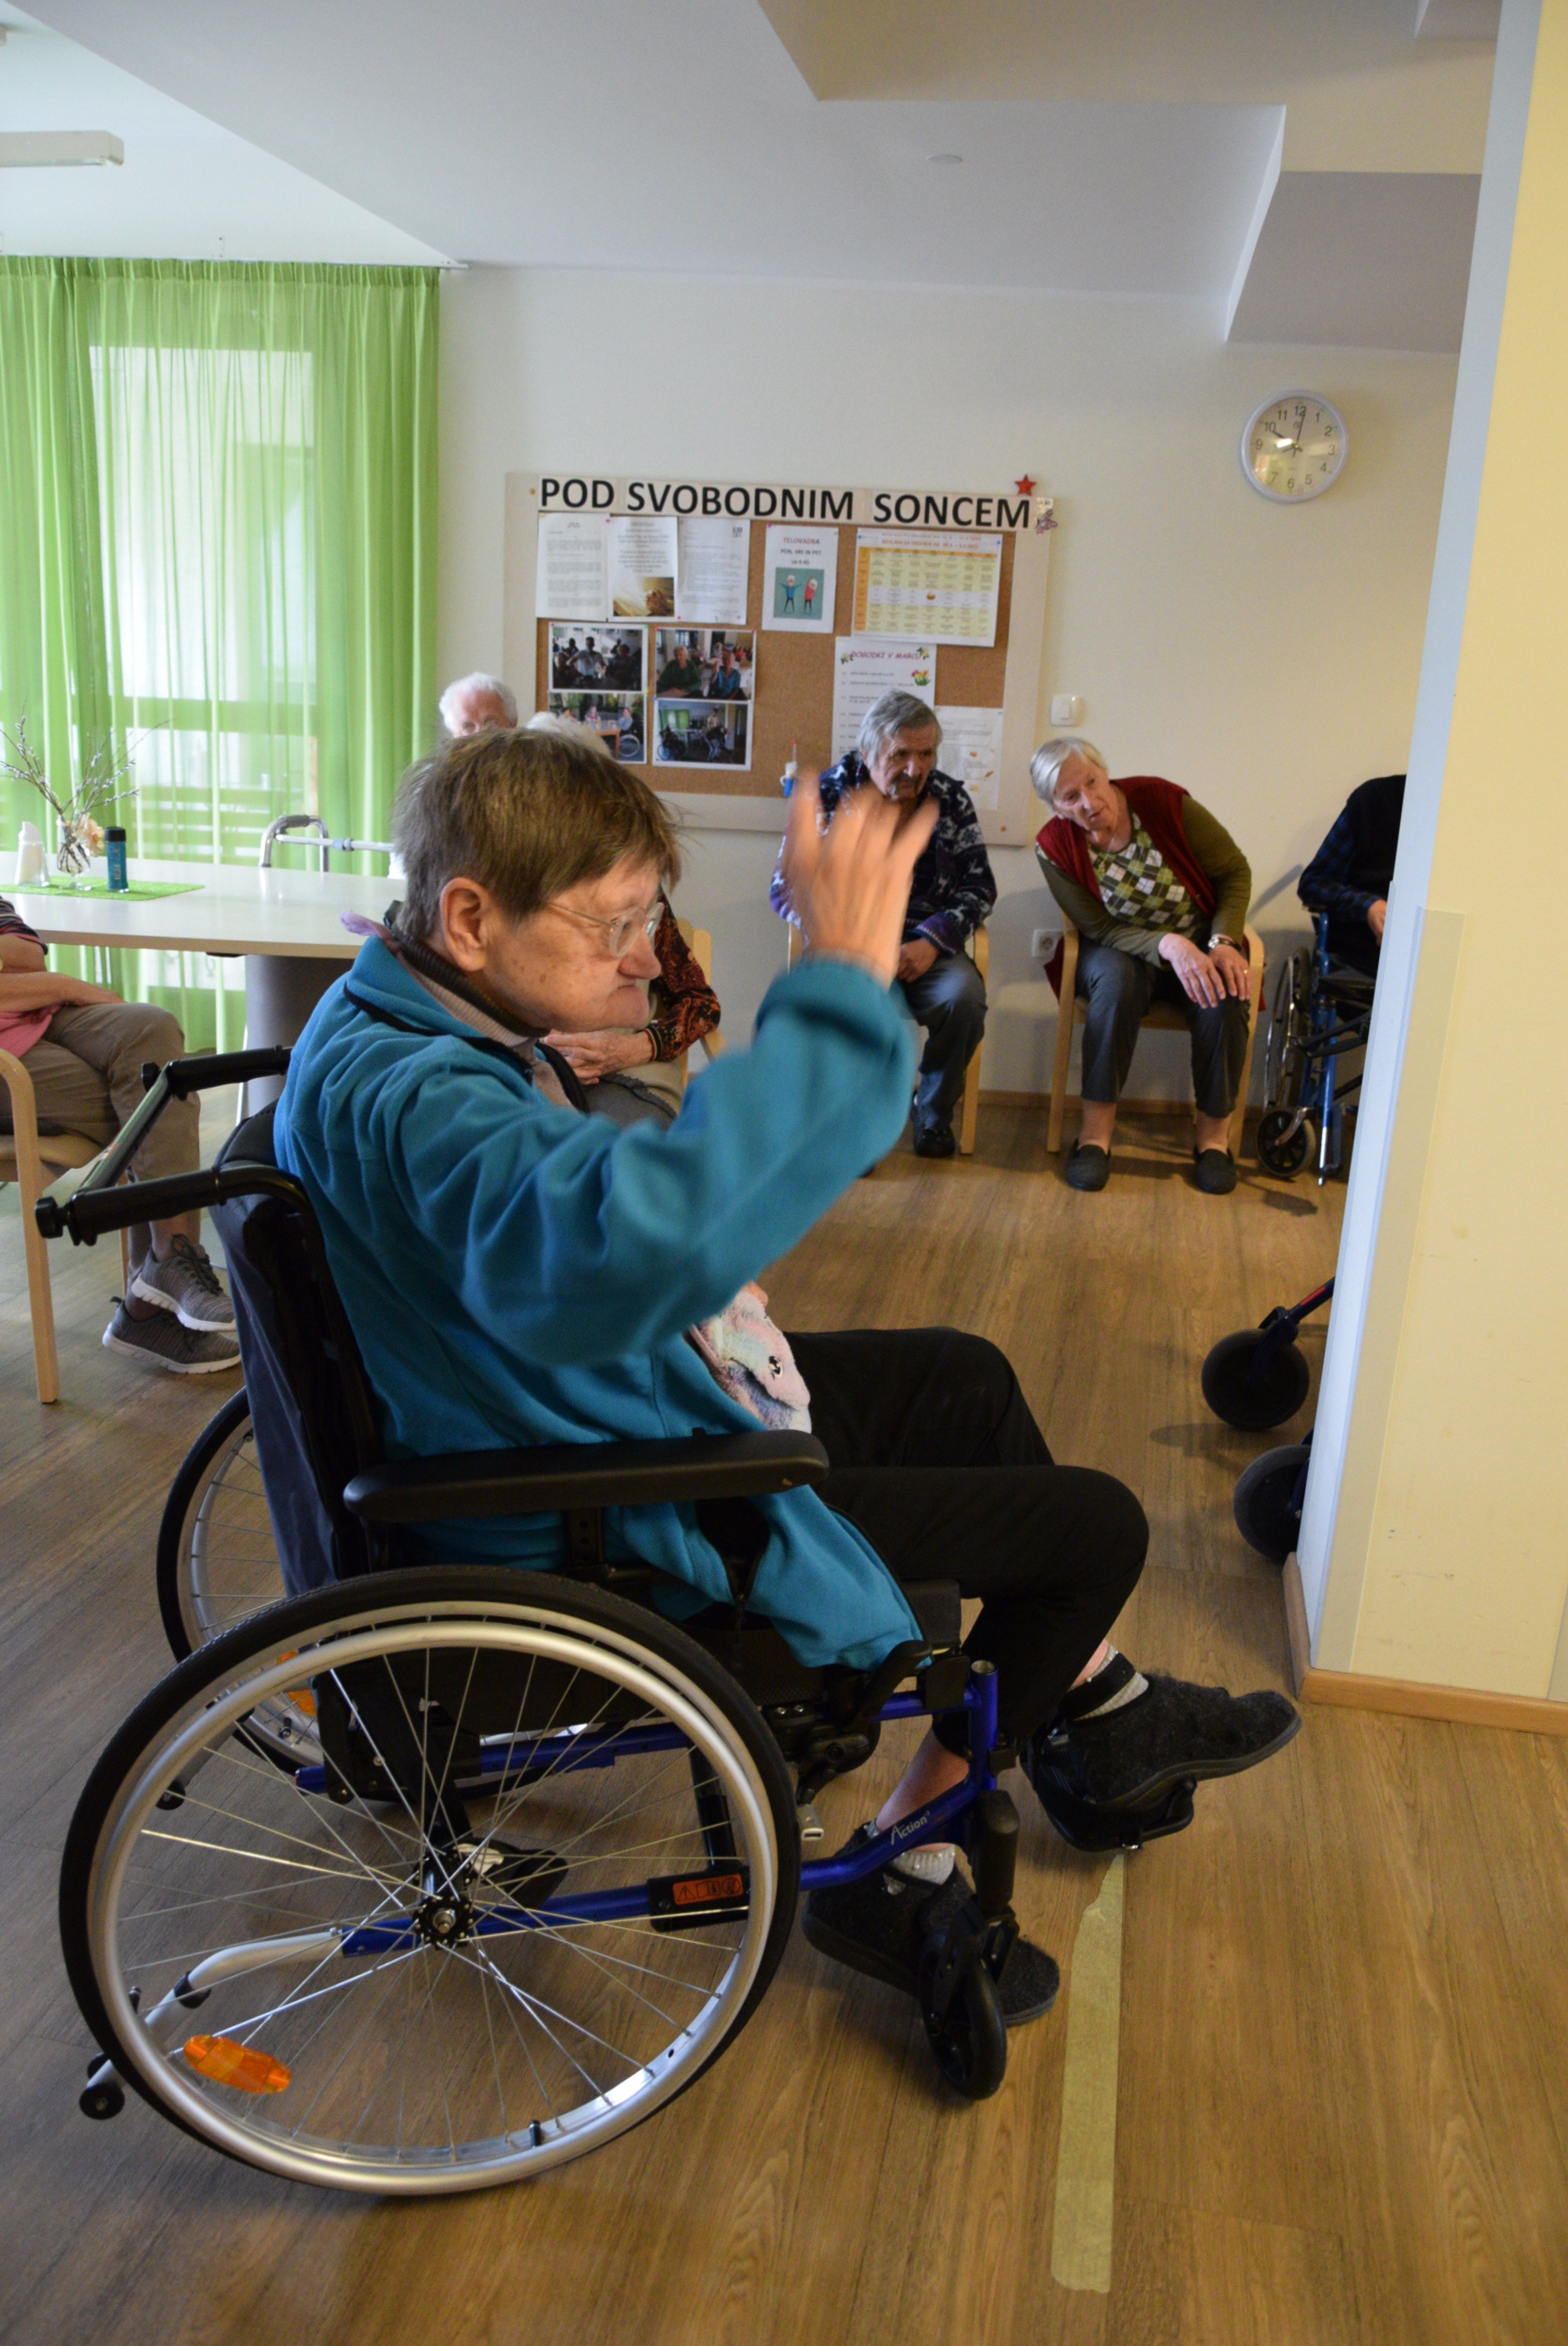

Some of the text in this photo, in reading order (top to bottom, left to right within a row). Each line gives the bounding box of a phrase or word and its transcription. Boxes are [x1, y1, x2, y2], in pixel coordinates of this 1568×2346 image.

[1278, 409, 1287, 420] 11
[1265, 421, 1276, 432] 10
[1324, 426, 1332, 437] 2
[1255, 439, 1263, 450] 9
[1328, 445, 1336, 456] 3
[1319, 463, 1327, 473] 4
[1287, 478, 1295, 489] 6
[1305, 474, 1312, 485] 5
[541, 478, 1030, 528] POD SVOBODNIM SONCEM
